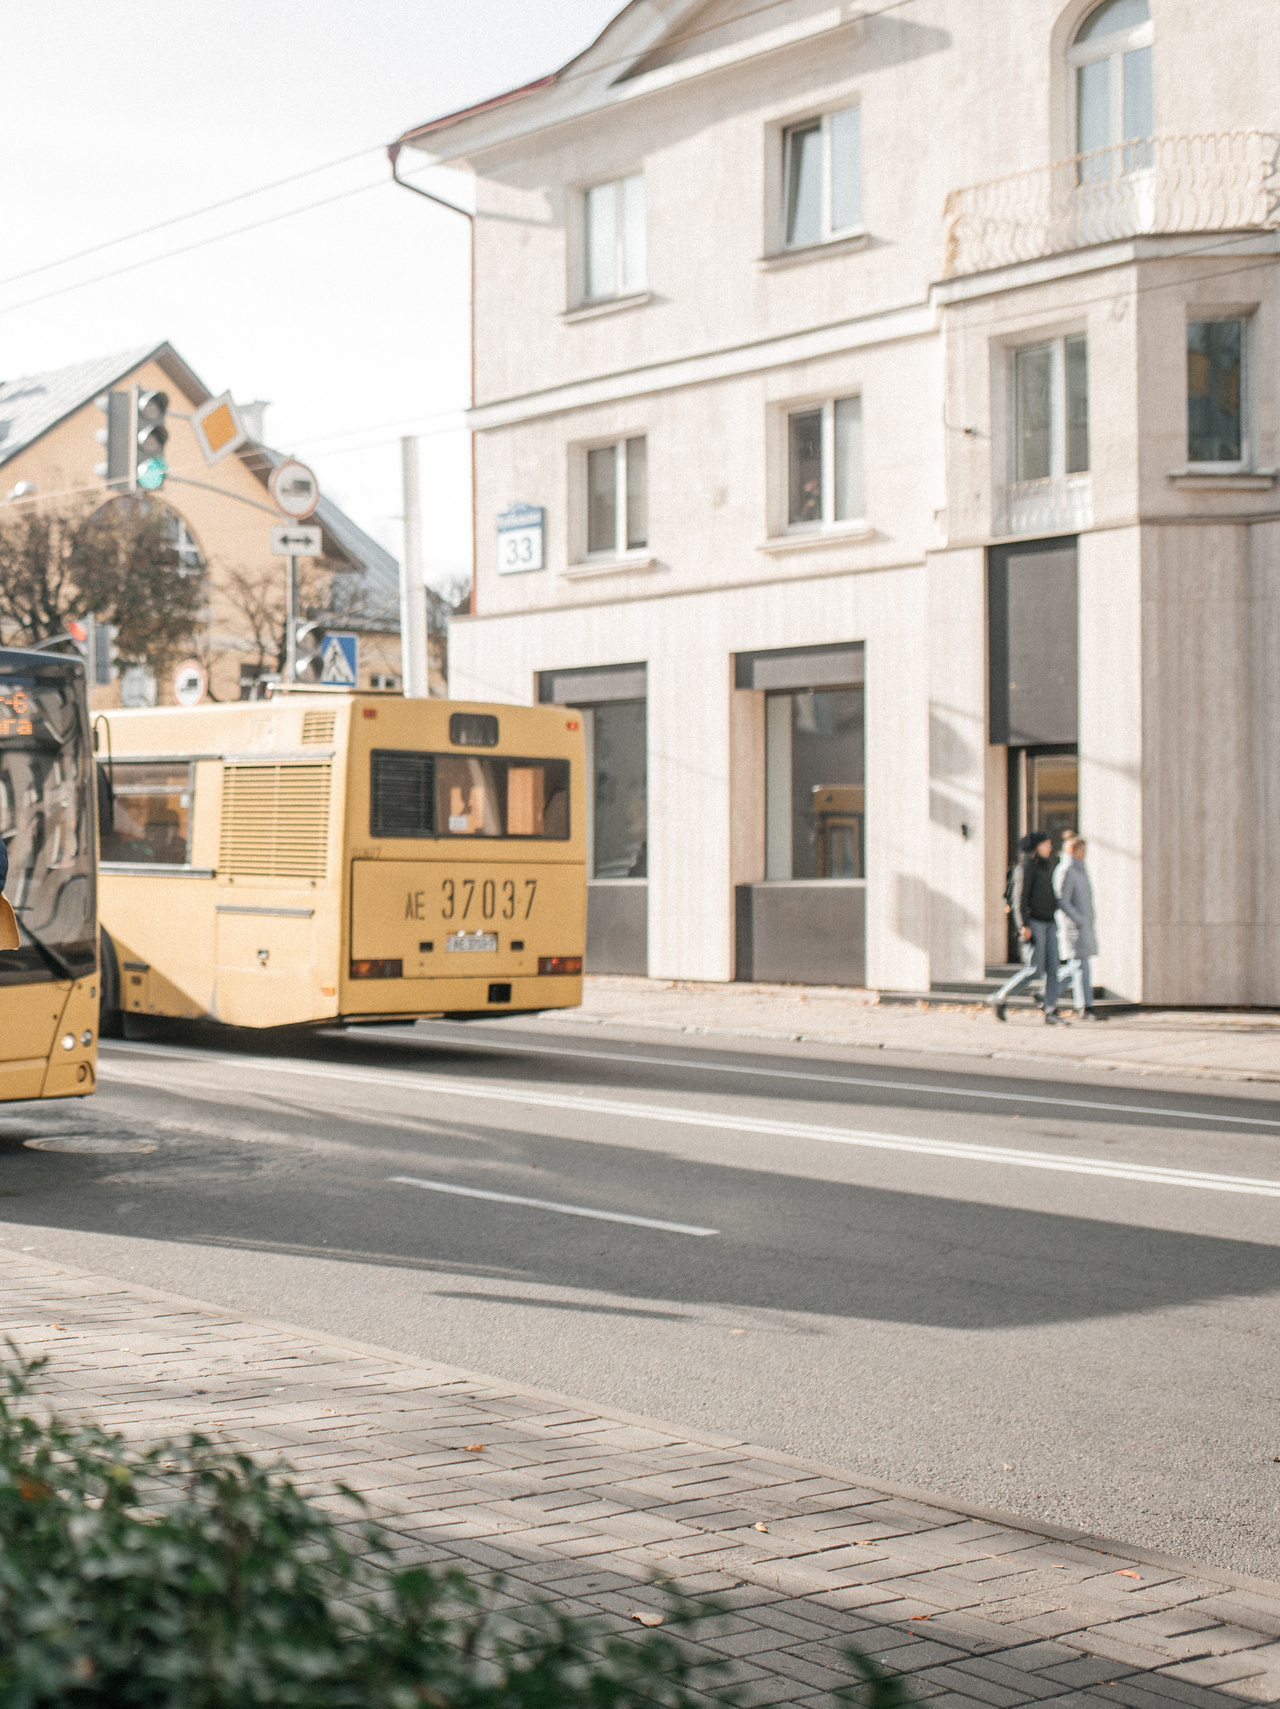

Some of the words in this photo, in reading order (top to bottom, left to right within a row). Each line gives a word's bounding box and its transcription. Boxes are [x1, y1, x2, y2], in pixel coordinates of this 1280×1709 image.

[506, 537, 533, 565] 33
[404, 891, 425, 920] AE
[441, 878, 538, 920] 37037
